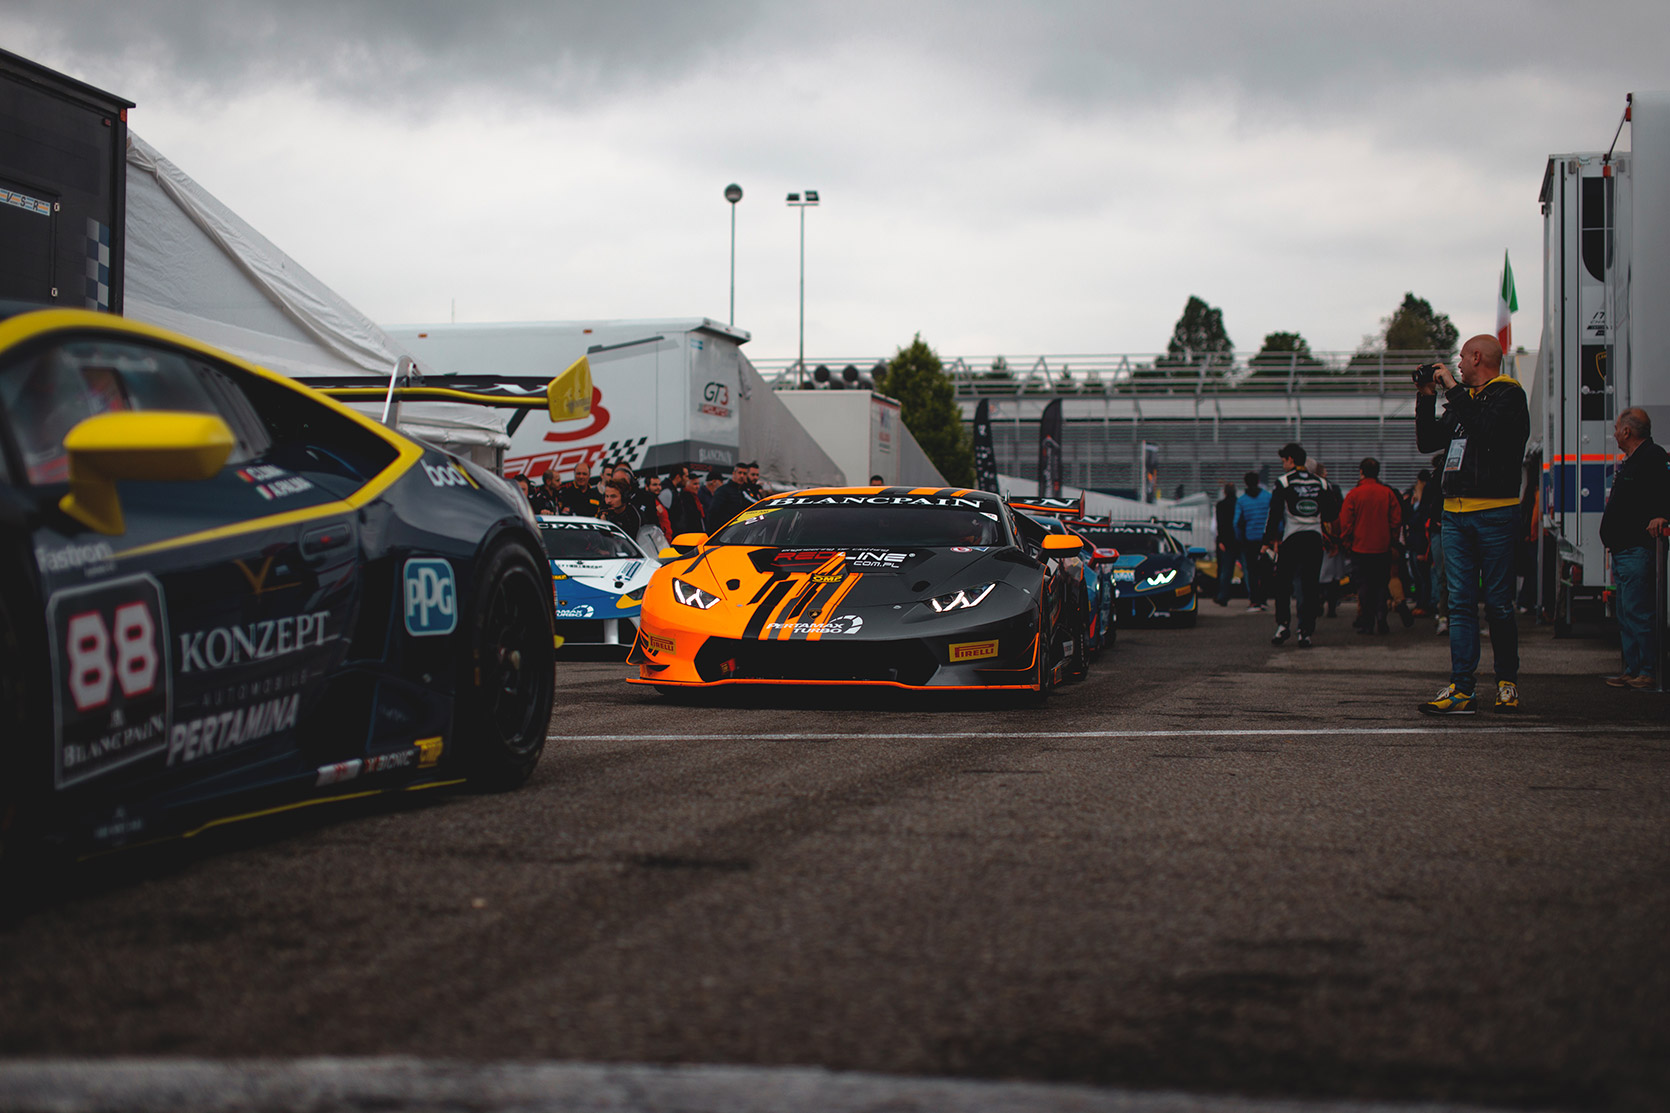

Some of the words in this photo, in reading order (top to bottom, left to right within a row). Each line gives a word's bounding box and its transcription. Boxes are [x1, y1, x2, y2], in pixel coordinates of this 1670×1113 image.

[703, 381, 729, 405] GT3
[764, 496, 981, 509] BLANCPAIN
[853, 560, 900, 569] COM.PL
[406, 567, 454, 627] PPG
[765, 622, 845, 631] PERTAMAX
[178, 610, 331, 672] KONZEPT
[649, 635, 674, 653] PIRELLI
[954, 644, 995, 658] PIRELLI
[65, 599, 160, 713] 88
[63, 713, 166, 768] BLANCPAIN
[166, 692, 300, 767] PERTAMINA
